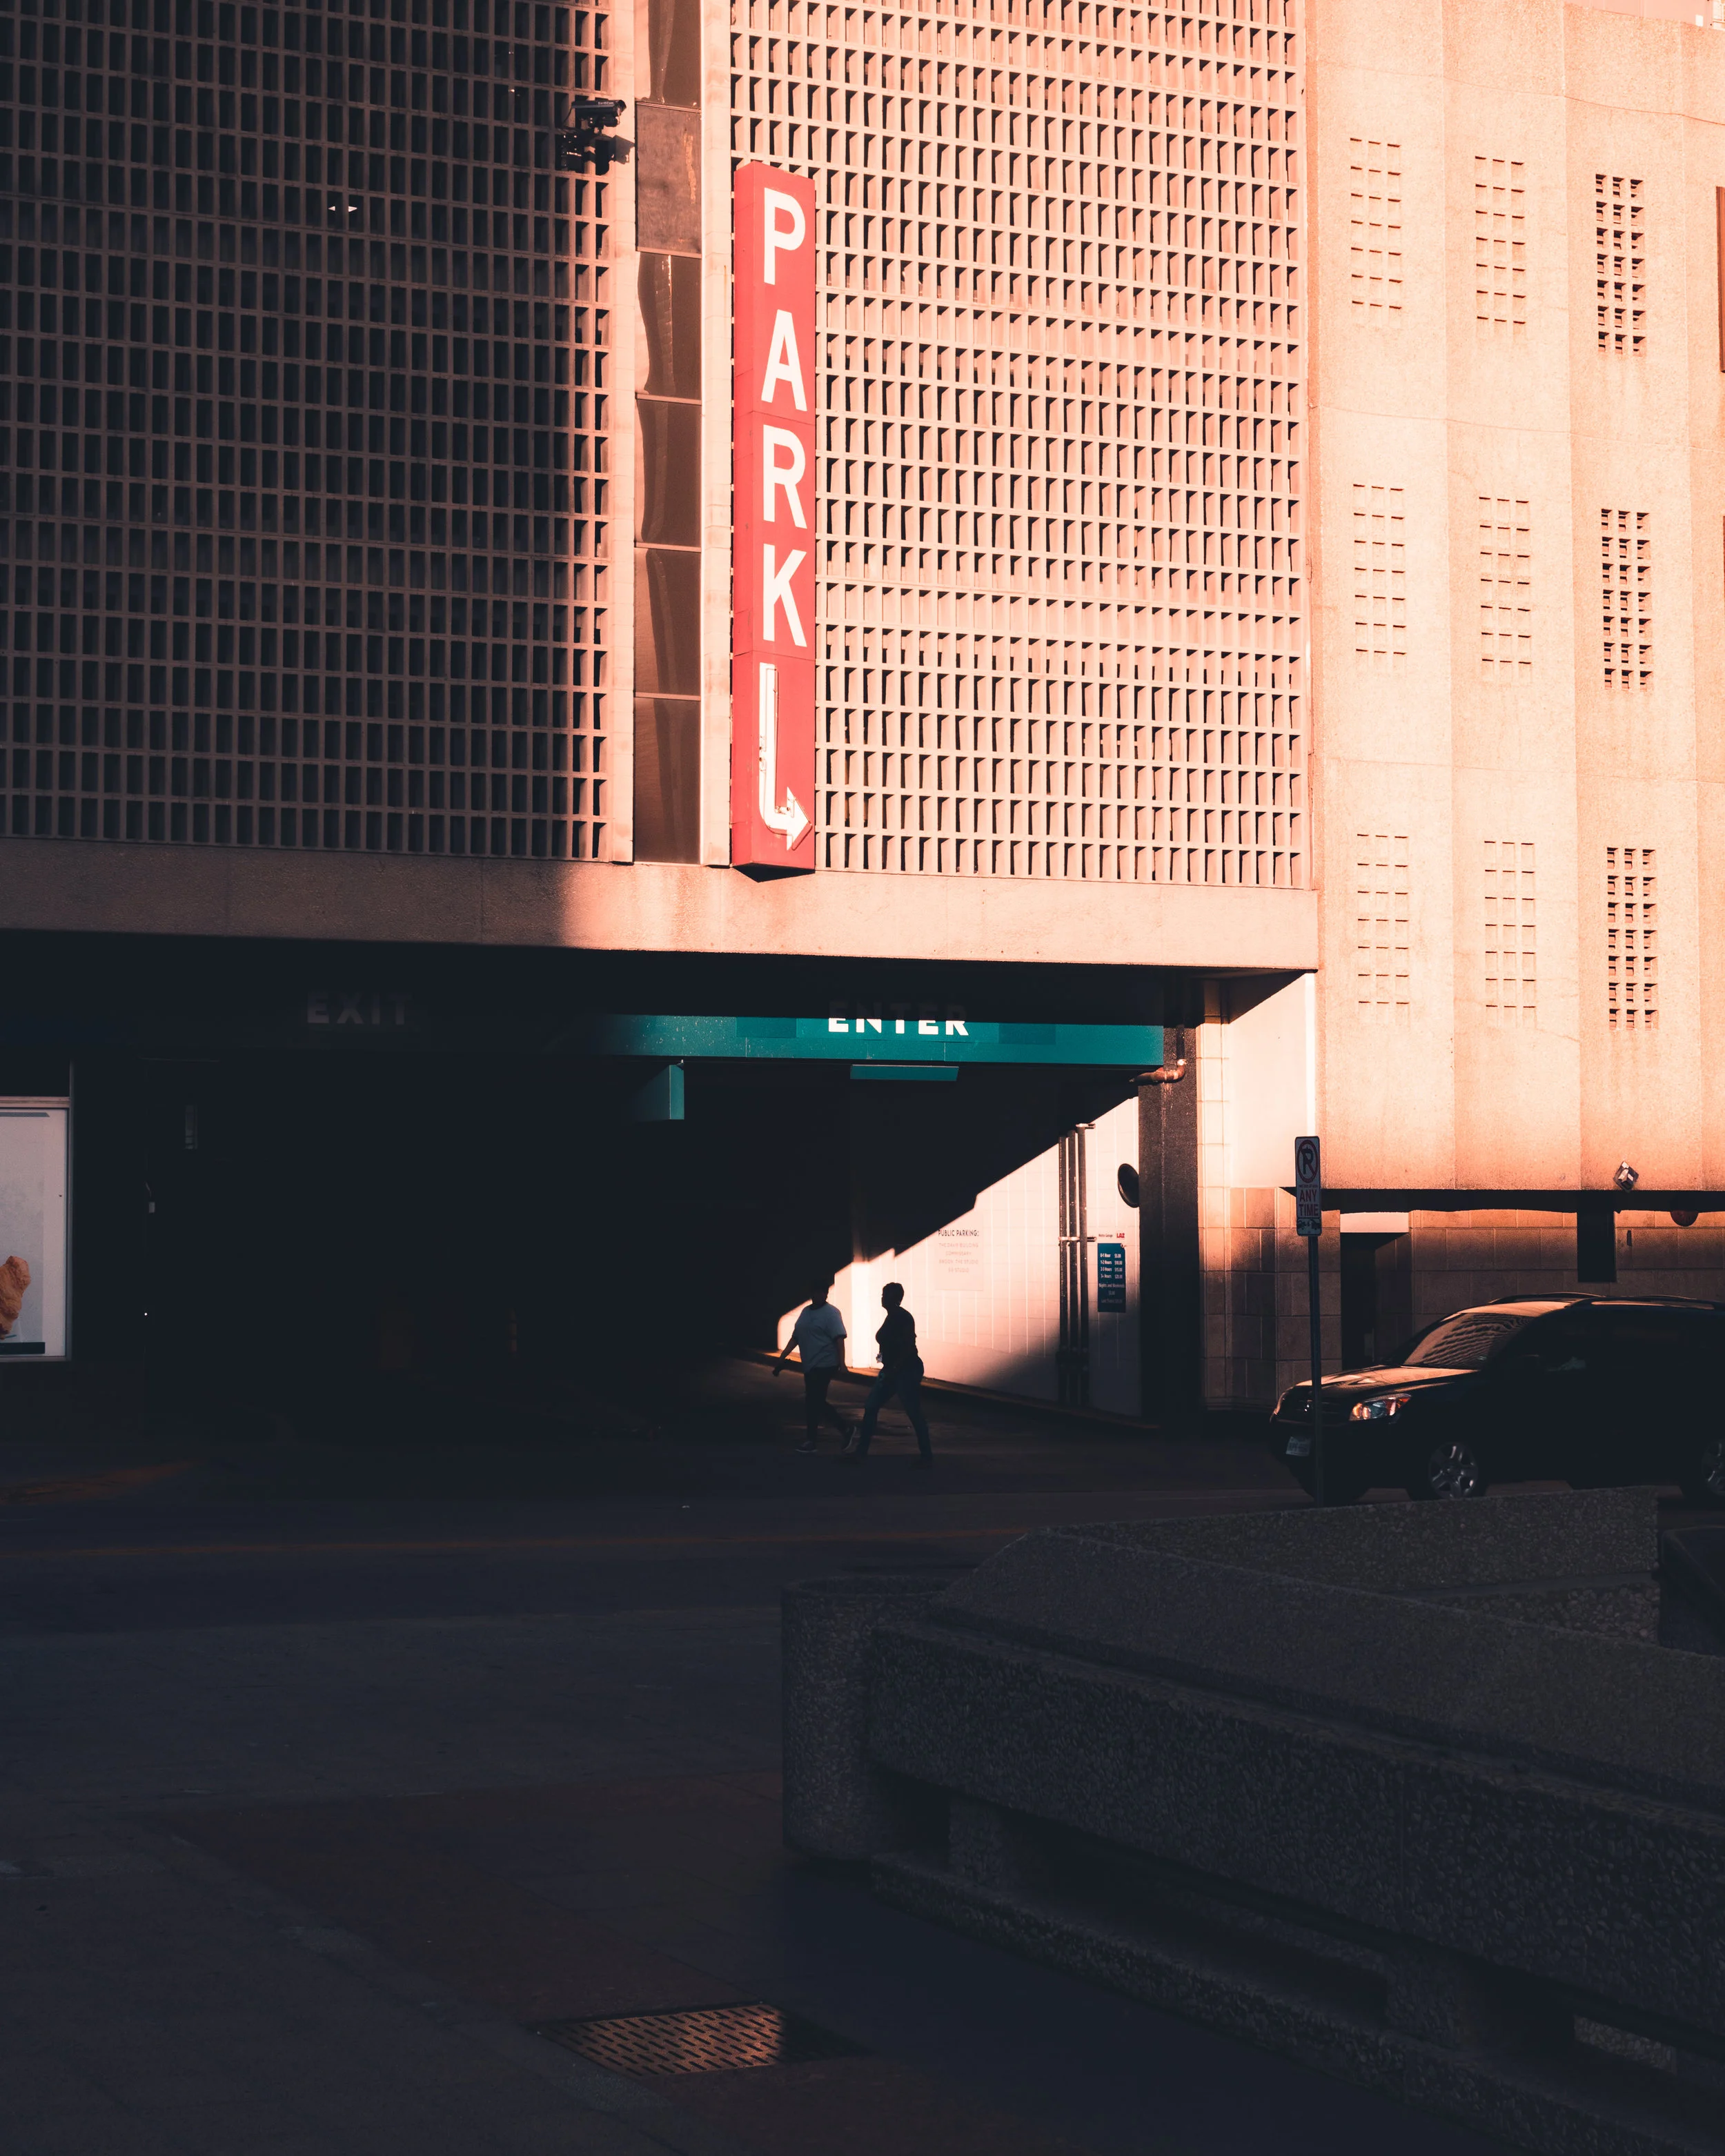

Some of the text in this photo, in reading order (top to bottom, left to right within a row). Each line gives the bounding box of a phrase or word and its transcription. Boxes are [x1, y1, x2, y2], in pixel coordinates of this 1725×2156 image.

[761, 187, 808, 647] PARK
[307, 991, 412, 1025] EXIT
[1299, 1189, 1317, 1202] ANY
[1299, 1204, 1319, 1216] TIME
